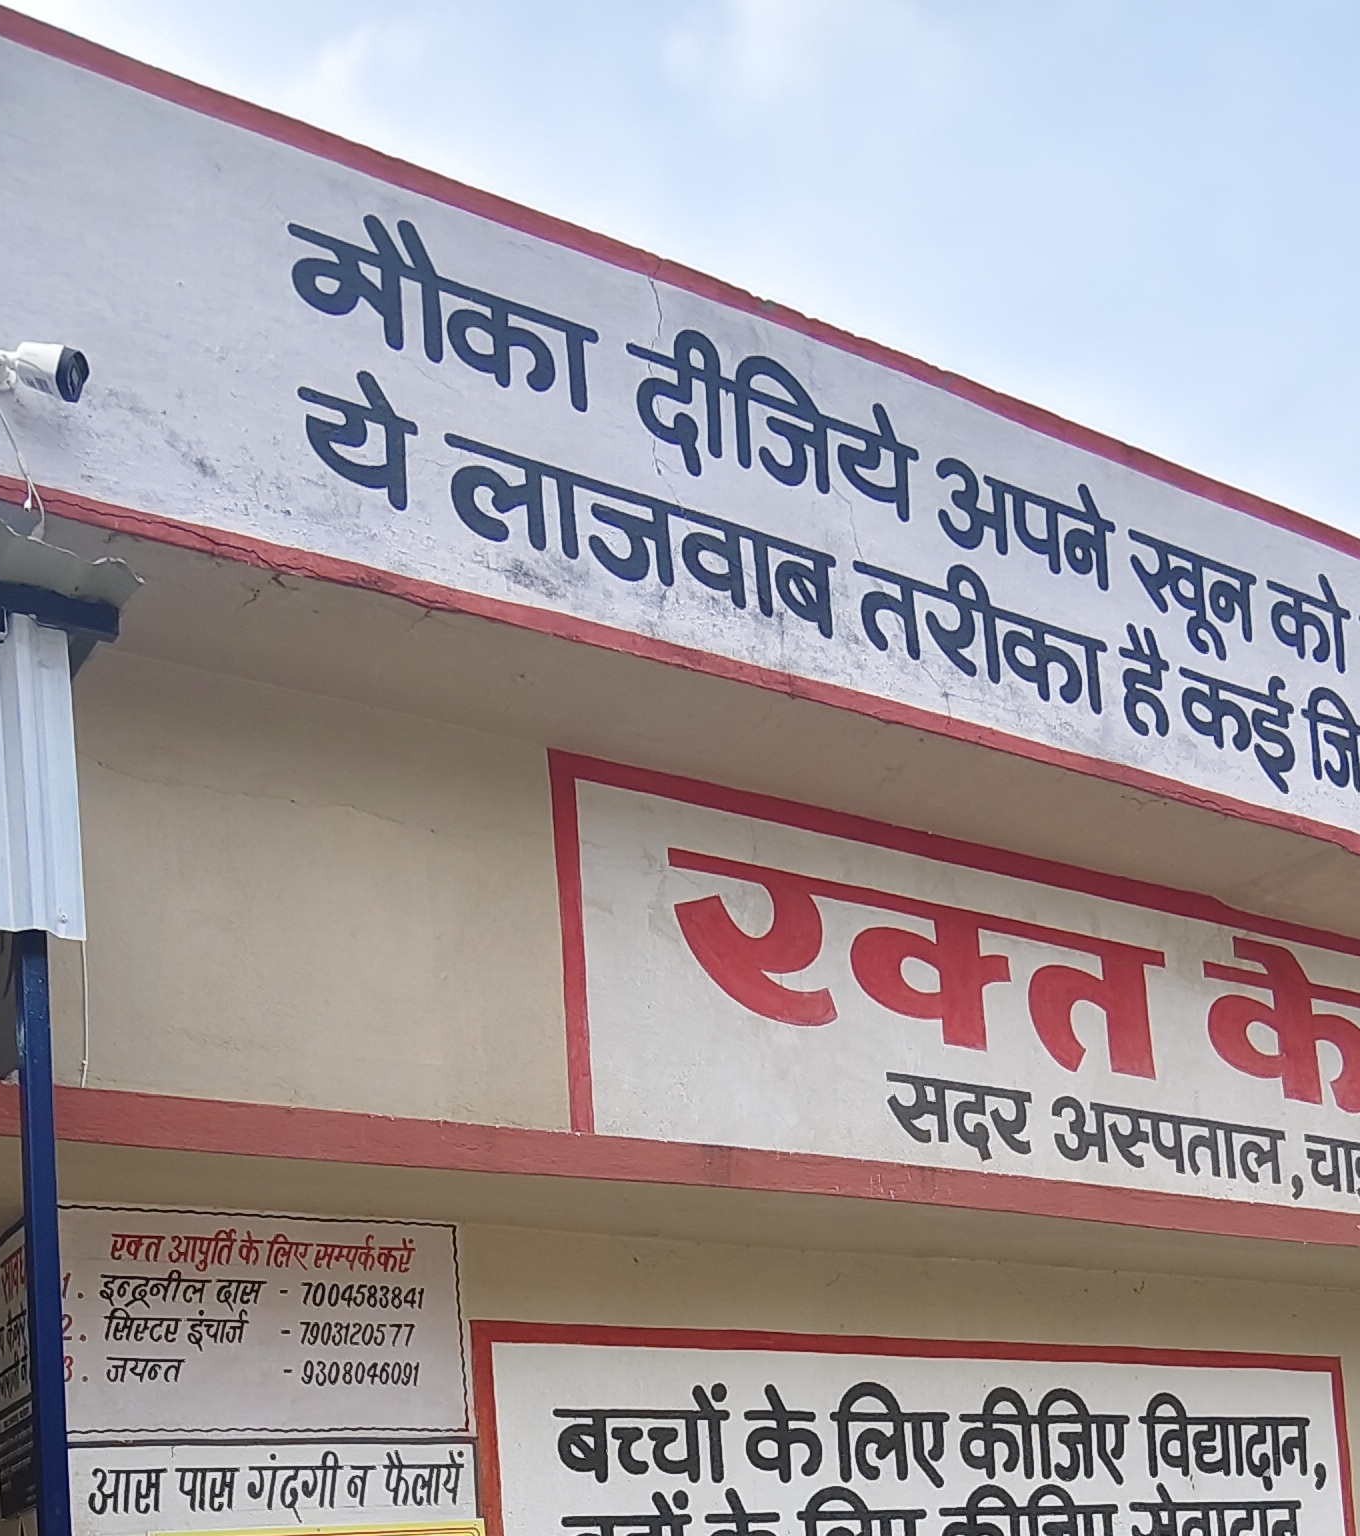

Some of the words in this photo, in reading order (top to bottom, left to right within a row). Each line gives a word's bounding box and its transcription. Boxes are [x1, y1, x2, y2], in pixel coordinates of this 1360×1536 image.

[288, 213, 598, 413] मौका
[625, 328, 920, 524] दीजिये
[935, 482, 1117, 592] अपने
[1127, 526, 1256, 662] खून
[1266, 572, 1352, 675] को
[296, 368, 419, 512] ये
[444, 431, 837, 640] लाजवाब
[853, 563, 1108, 715] तरीका
[1120, 621, 1169, 738] है
[1179, 674, 1295, 795] कई
[667, 846, 1165, 1081] रक्त
[885, 1069, 1031, 1164] सदर
[111, 1232, 166, 1262] रक्त
[238, 1228, 260, 1264] के
[265, 1233, 313, 1272] लिए
[104, 1309, 183, 1345] सिस्टर
[299, 1321, 416, 1348] 7903120577
[215, 1278, 268, 1312] दास
[300, 1281, 426, 1311] 7004583841
[105, 1355, 187, 1385] जयन्त
[300, 1360, 421, 1388] 9308046091
[552, 1381, 730, 1484] बच्चों
[744, 1383, 825, 1482] के
[829, 1381, 950, 1487] लिए
[959, 1386, 1130, 1486] कीजिए
[89, 1466, 168, 1515] आस
[174, 1465, 240, 1513] पास
[247, 1451, 344, 1524] गंदगी
[344, 1464, 377, 1507] न
